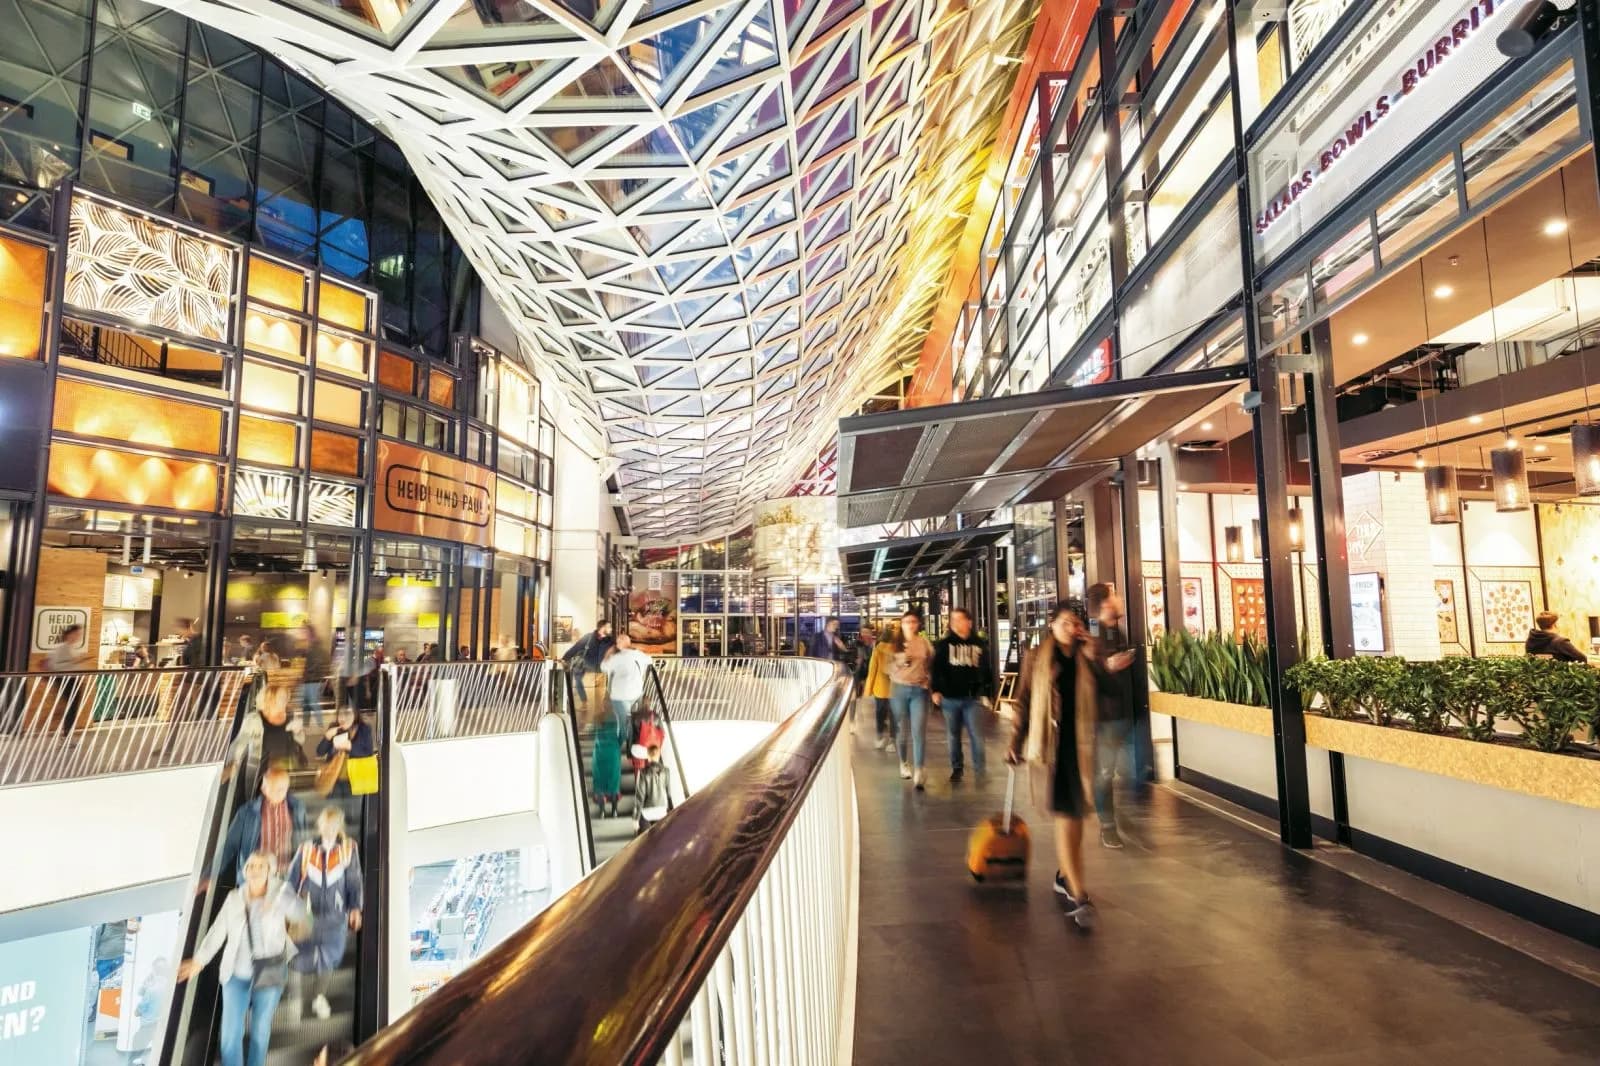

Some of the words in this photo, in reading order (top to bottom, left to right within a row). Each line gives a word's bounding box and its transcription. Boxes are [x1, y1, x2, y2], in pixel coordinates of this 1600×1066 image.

[1256, 170, 1313, 234] SALADS
[1320, 95, 1390, 172] BOWLS
[397, 479, 431, 504] HEIDI
[436, 488, 459, 509] UND
[48, 614, 77, 624] HEIDI
[51, 624, 67, 635] UN
[0, 1005, 46, 1039] N?
